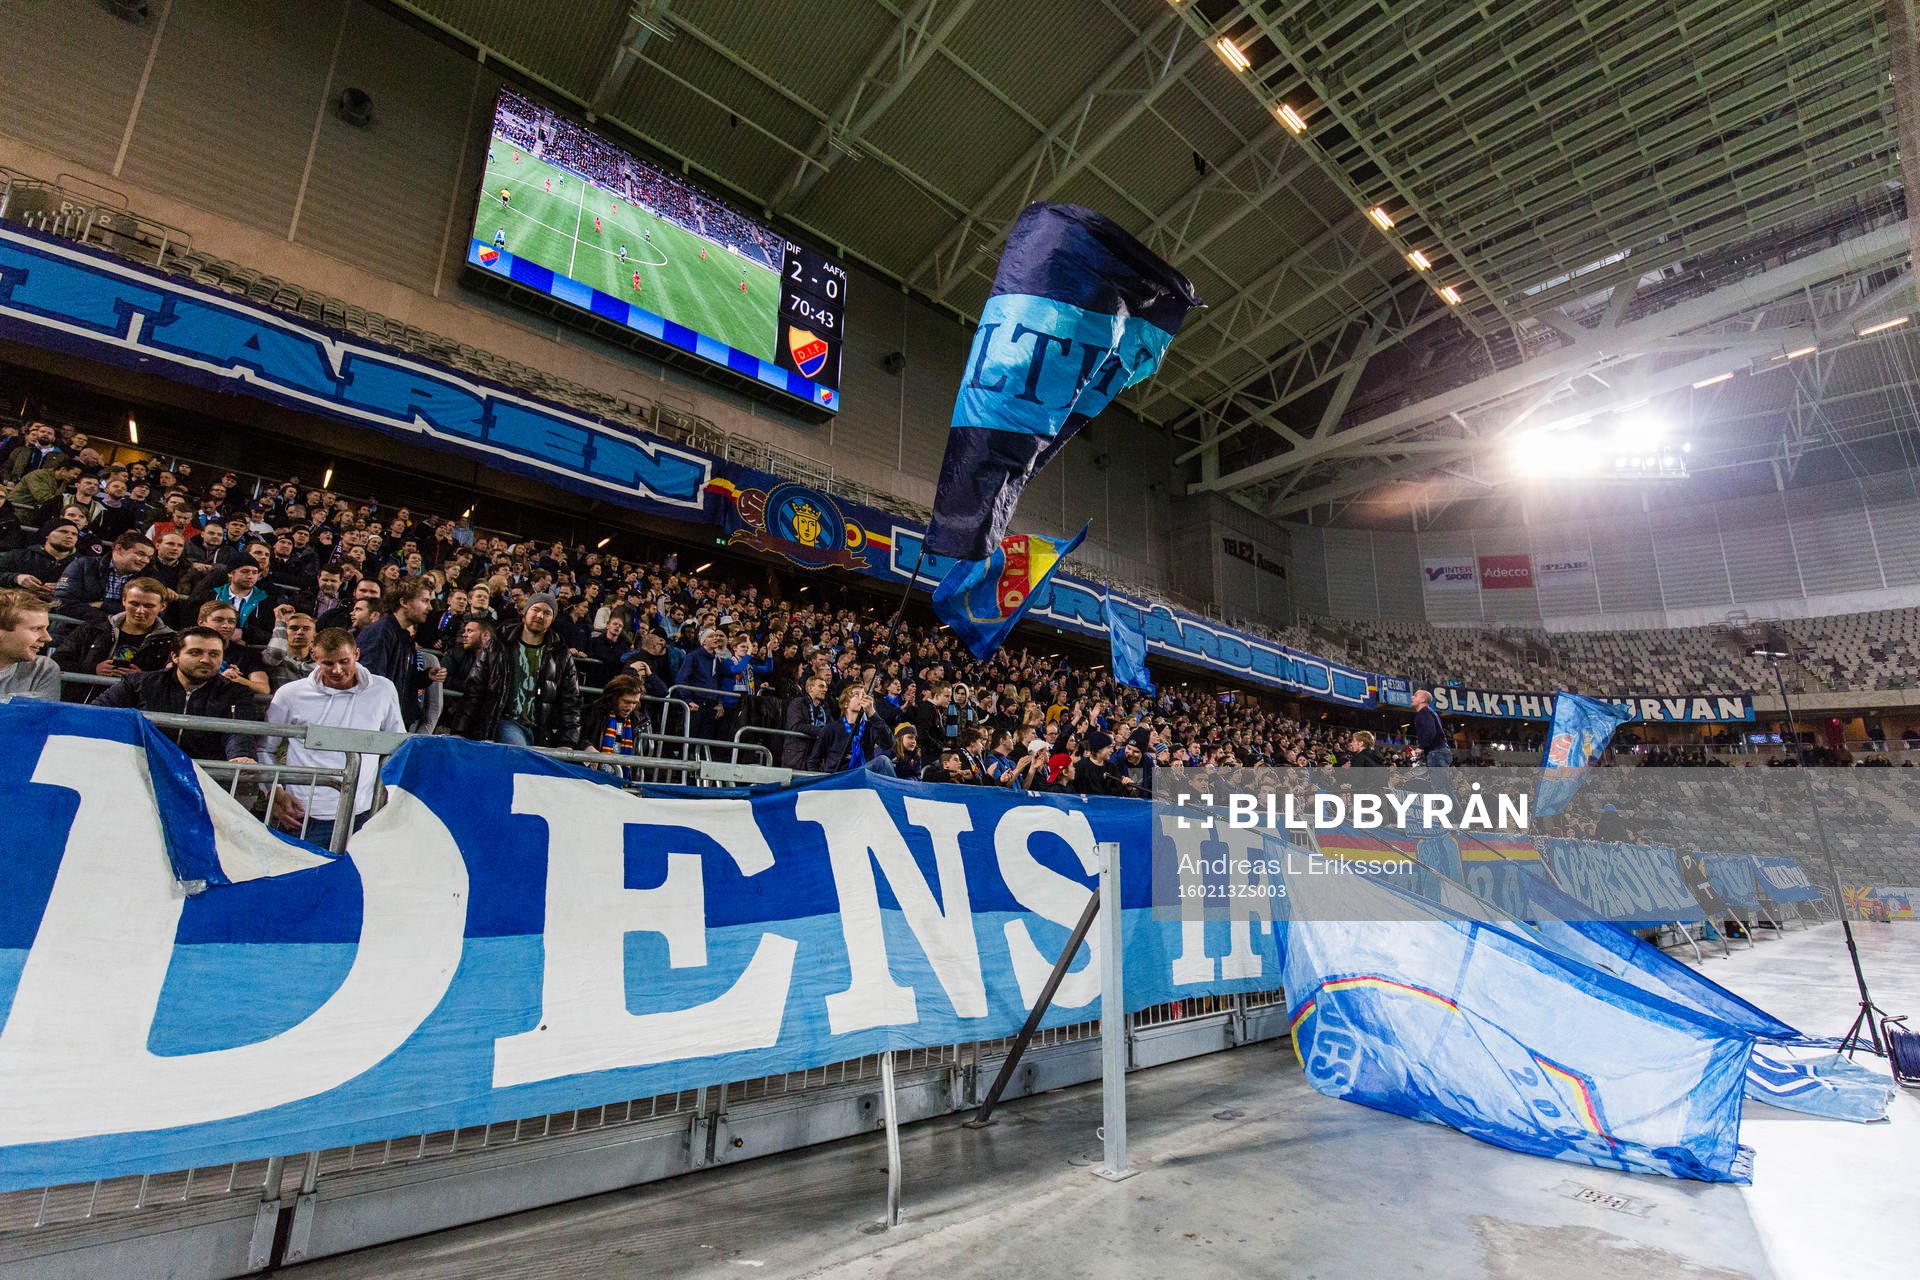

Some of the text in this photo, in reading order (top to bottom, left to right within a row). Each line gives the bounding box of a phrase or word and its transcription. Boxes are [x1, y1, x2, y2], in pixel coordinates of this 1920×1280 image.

[786, 241, 801, 255] DIF
[791, 260, 803, 282] 2
[826, 279, 838, 299] 0
[823, 262, 845, 280] AAFK
[790, 293, 834, 328] 70:43
[1444, 566, 1472, 574] INTER
[1484, 567, 1529, 578] Adecco
[0, 735, 1281, 1145] DENS IF
